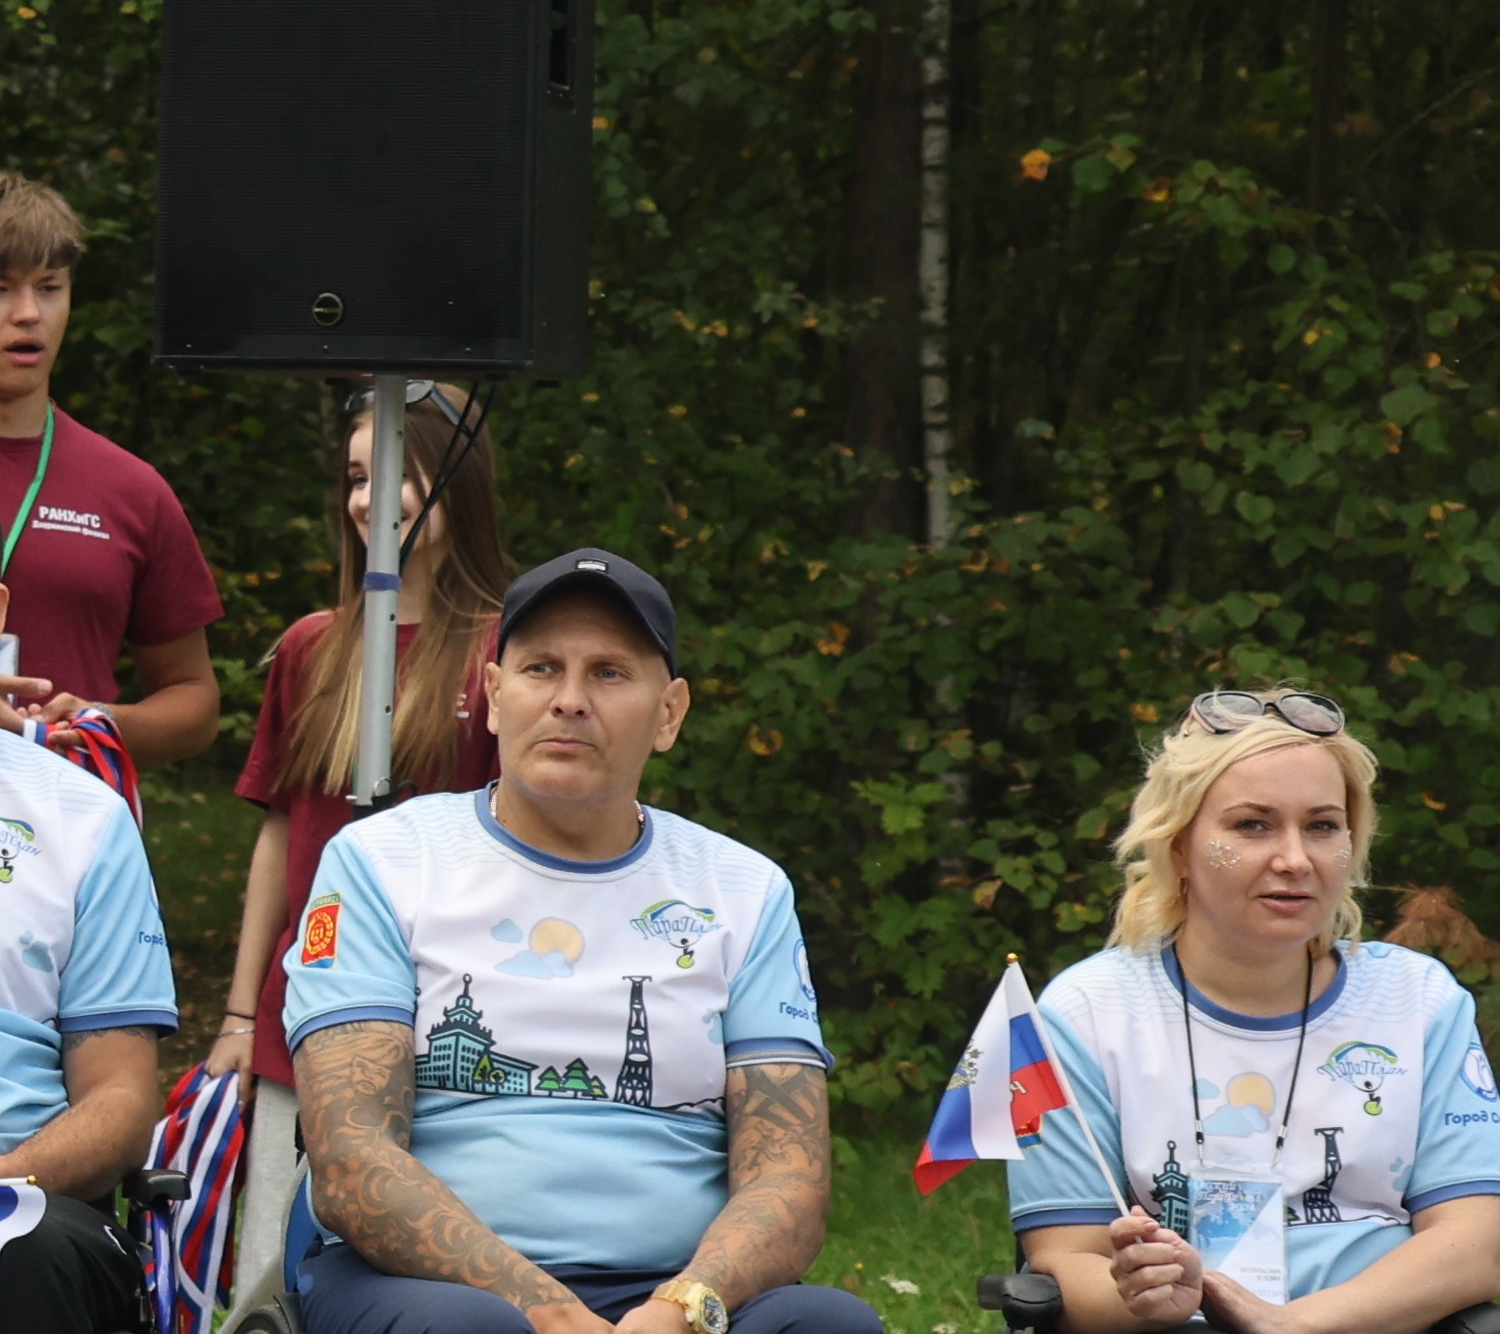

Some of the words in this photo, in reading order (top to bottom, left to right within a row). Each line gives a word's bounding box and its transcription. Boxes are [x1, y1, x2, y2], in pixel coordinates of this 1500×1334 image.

[39, 506, 101, 529] РАНХиГС
[780, 1001, 810, 1021] Город
[1445, 1110, 1488, 1127] Город
